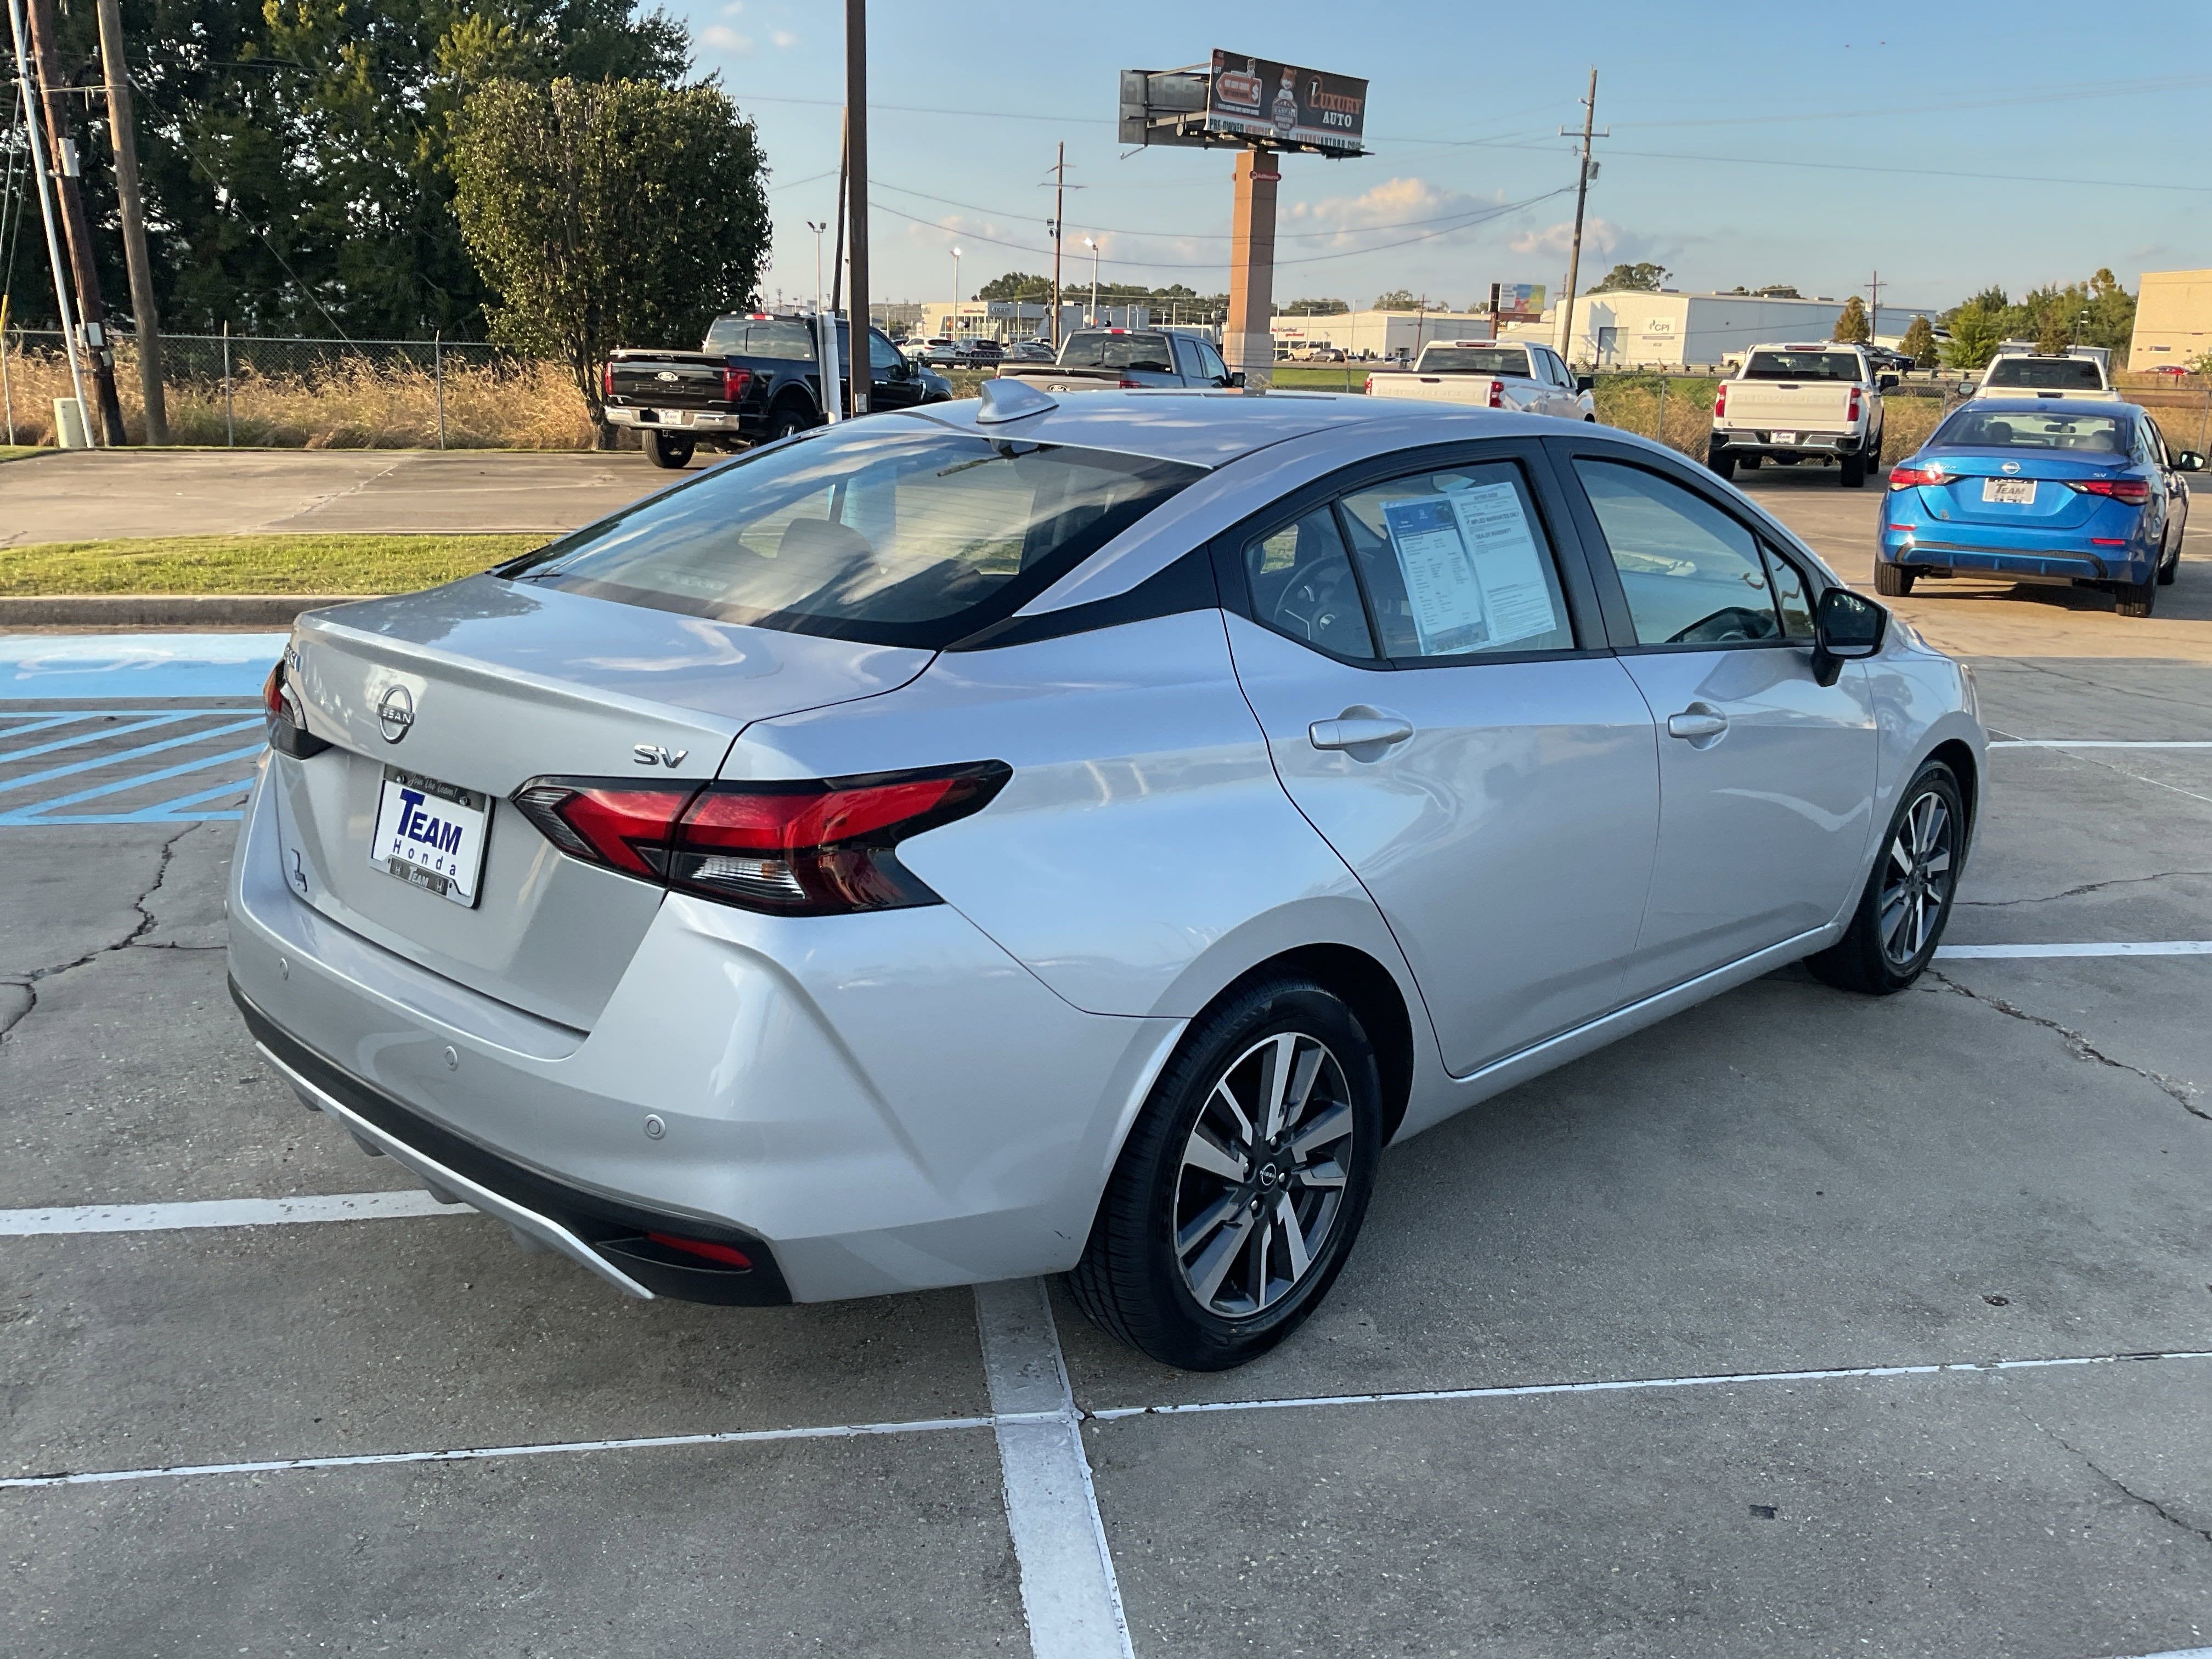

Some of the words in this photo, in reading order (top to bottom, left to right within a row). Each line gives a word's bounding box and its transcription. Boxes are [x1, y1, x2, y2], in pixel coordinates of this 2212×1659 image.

[1309, 82, 1362, 115] LUXURY
[1322, 111, 1352, 127] AUTO
[1995, 483, 2025, 494] TEAM
[634, 744, 689, 769] SV
[397, 788, 463, 856] TEAM
[393, 838, 456, 876] Honda
[408, 866, 429, 887] TEAM
